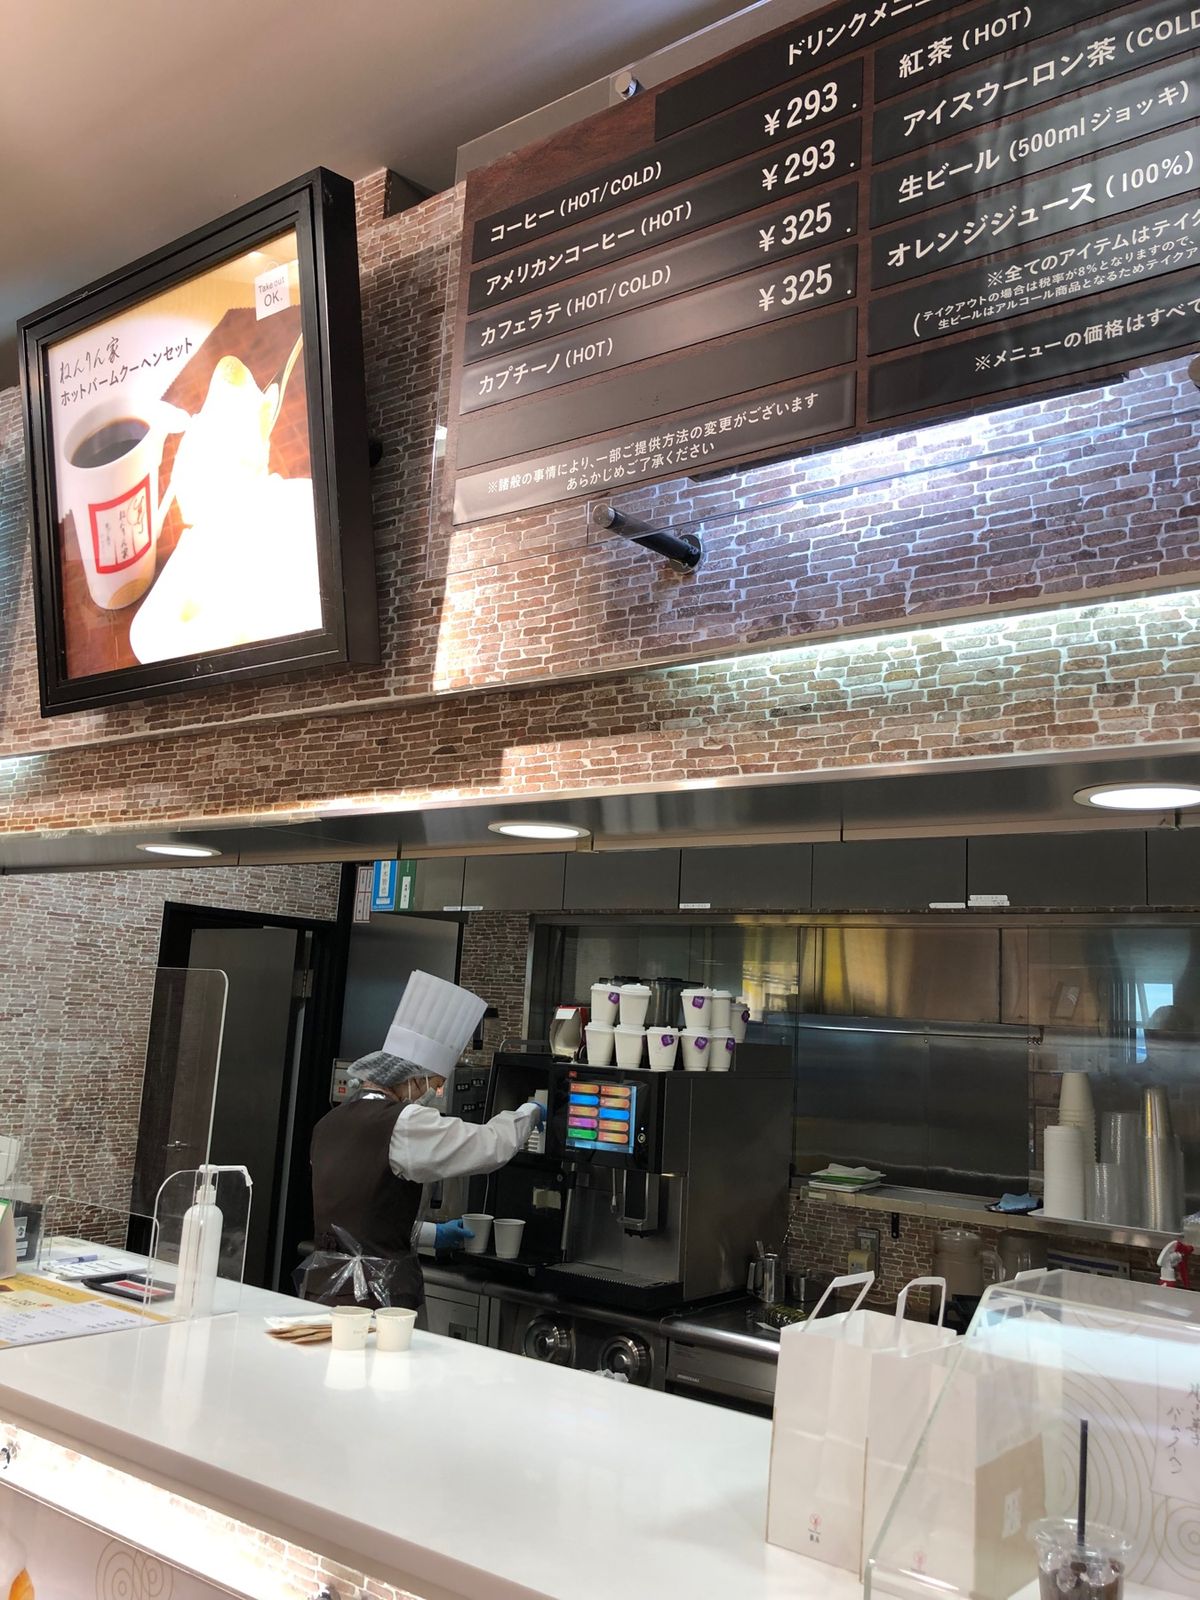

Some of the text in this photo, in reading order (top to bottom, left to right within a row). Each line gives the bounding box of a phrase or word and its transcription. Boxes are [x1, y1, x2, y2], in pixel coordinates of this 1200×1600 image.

[788, 0, 932, 66] ドリンクメニ
[899, 6, 1032, 78] 紅茶 (HOT)
[904, 36, 1116, 136] アイスウーロン茶
[491, 161, 662, 242] コーヒー (HOT/COLD)
[887, 150, 1193, 268] オレンジジュース (100%)
[899, 148, 1000, 203] 生ビール
[486, 201, 692, 295] アメリカンコーヒー (HOT)
[481, 265, 671, 346] カフェラテ (HOT/COLD)
[60, 336, 120, 384] ねんりん家
[61, 337, 193, 406] ホットバームクーヘンセット
[479, 338, 613, 396] カプチーノ (HOT)
[566, 442, 714, 491] あらかじめご了承ください
